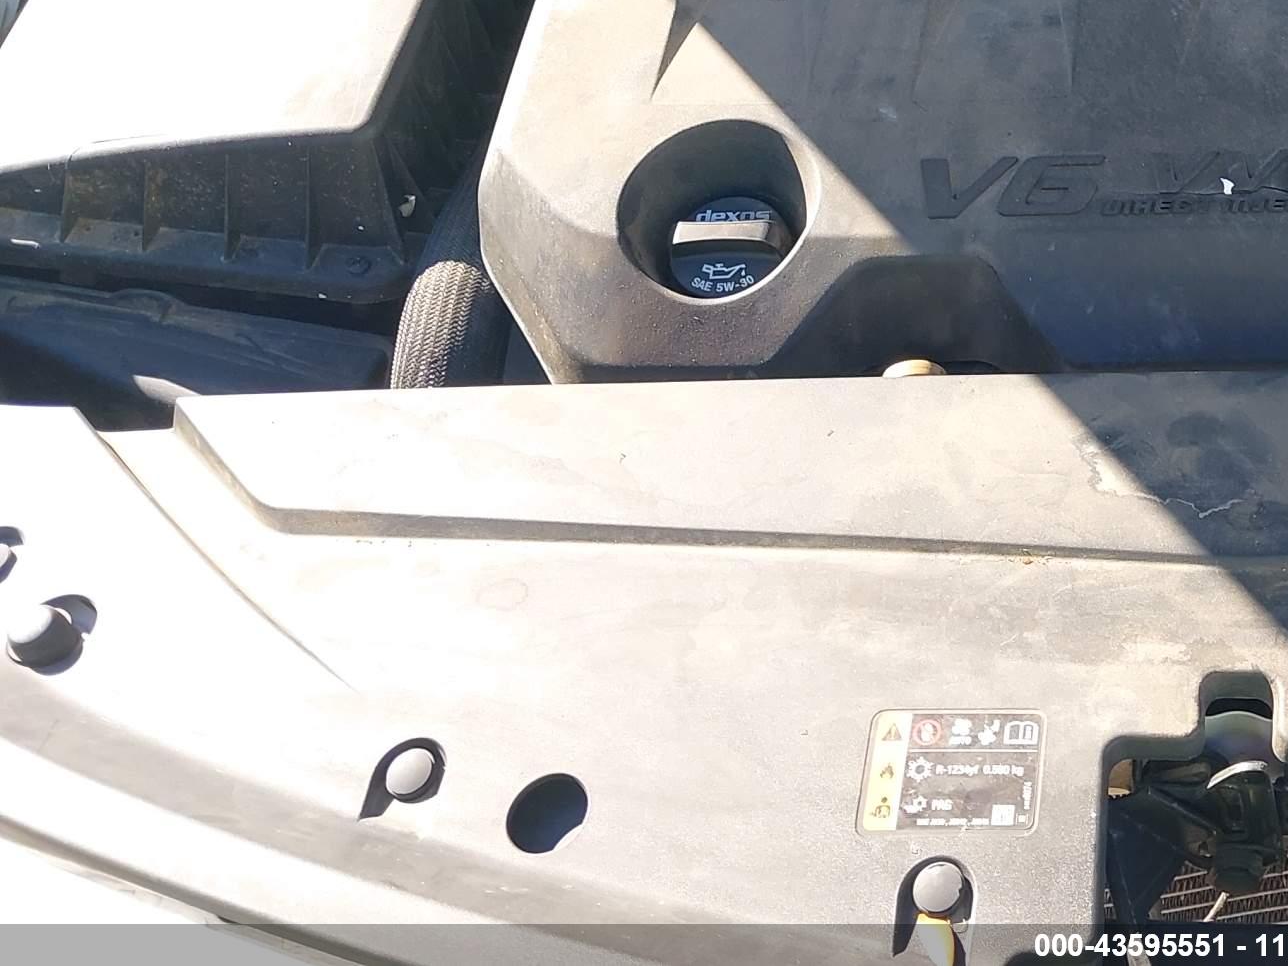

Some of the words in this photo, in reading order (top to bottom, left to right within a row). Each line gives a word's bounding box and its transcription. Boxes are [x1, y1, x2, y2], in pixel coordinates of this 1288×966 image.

[920, 155, 1106, 220] V6
[696, 209, 772, 222] dexos
[1101, 197, 1213, 217] DIRECT
[691, 277, 713, 292] SAE
[715, 275, 755, 292] 5W-30
